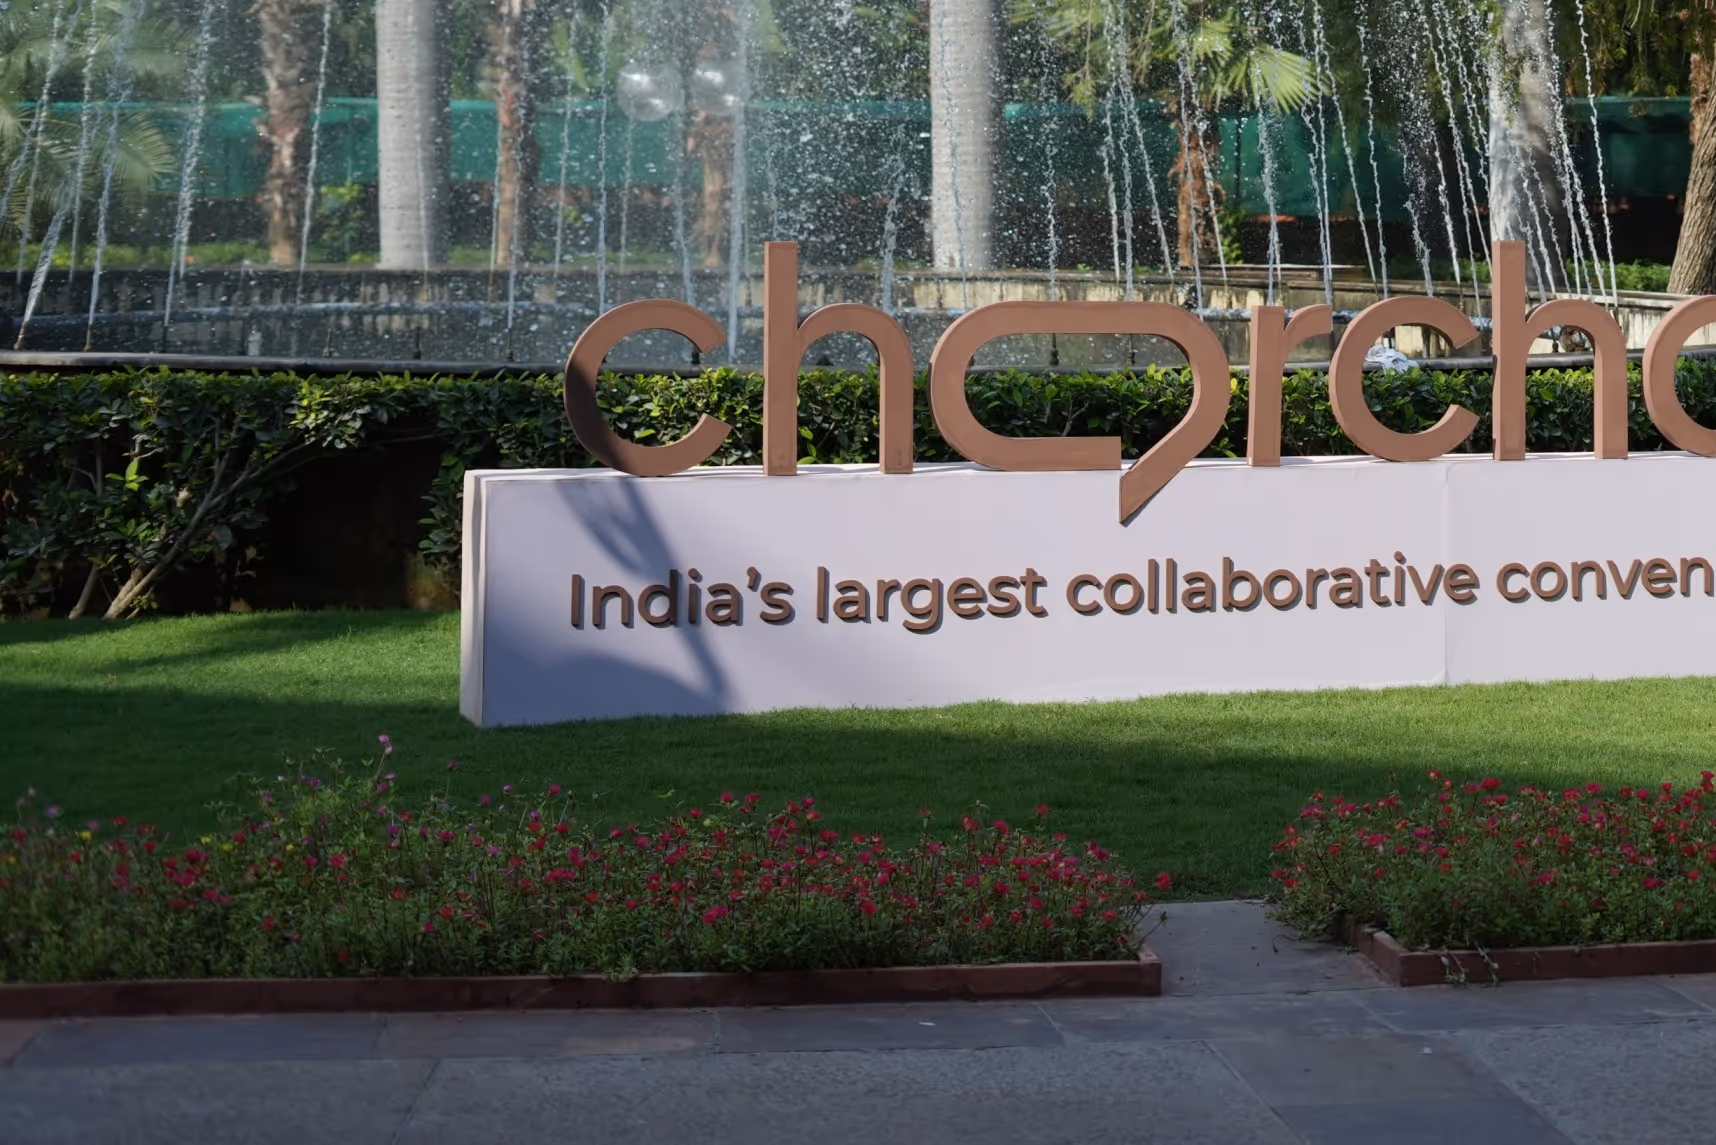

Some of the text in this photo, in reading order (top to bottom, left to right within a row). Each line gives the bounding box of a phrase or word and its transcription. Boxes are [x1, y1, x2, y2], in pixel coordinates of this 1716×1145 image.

[570, 566, 796, 628] India’s
[816, 566, 1047, 634] largest
[1066, 551, 1480, 616] collaborative
